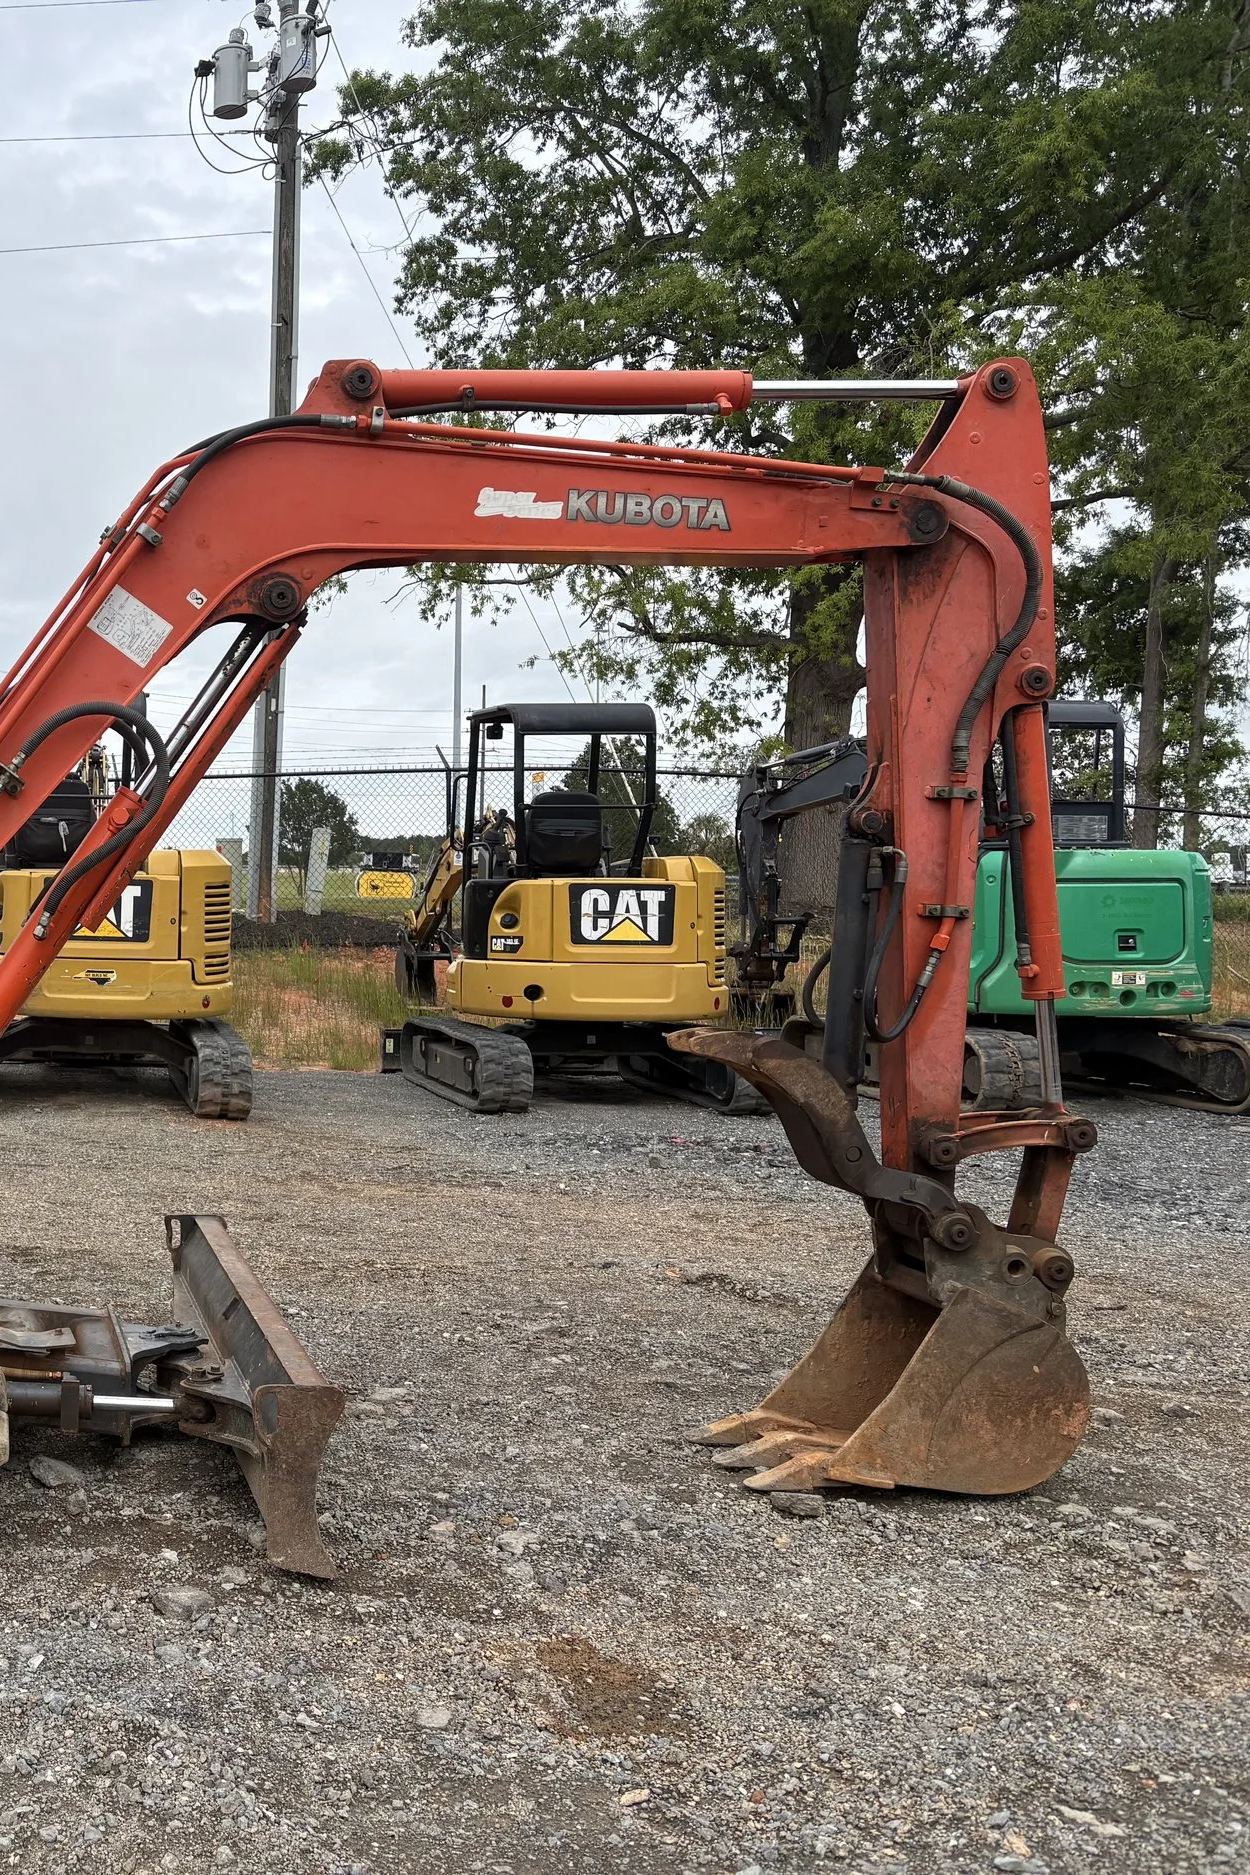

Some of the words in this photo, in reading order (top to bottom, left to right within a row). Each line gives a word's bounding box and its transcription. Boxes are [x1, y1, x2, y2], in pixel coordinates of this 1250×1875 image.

[567, 488, 731, 531] KUBOTA
[580, 889, 665, 942] CAT
[492, 938, 505, 951] CAT
